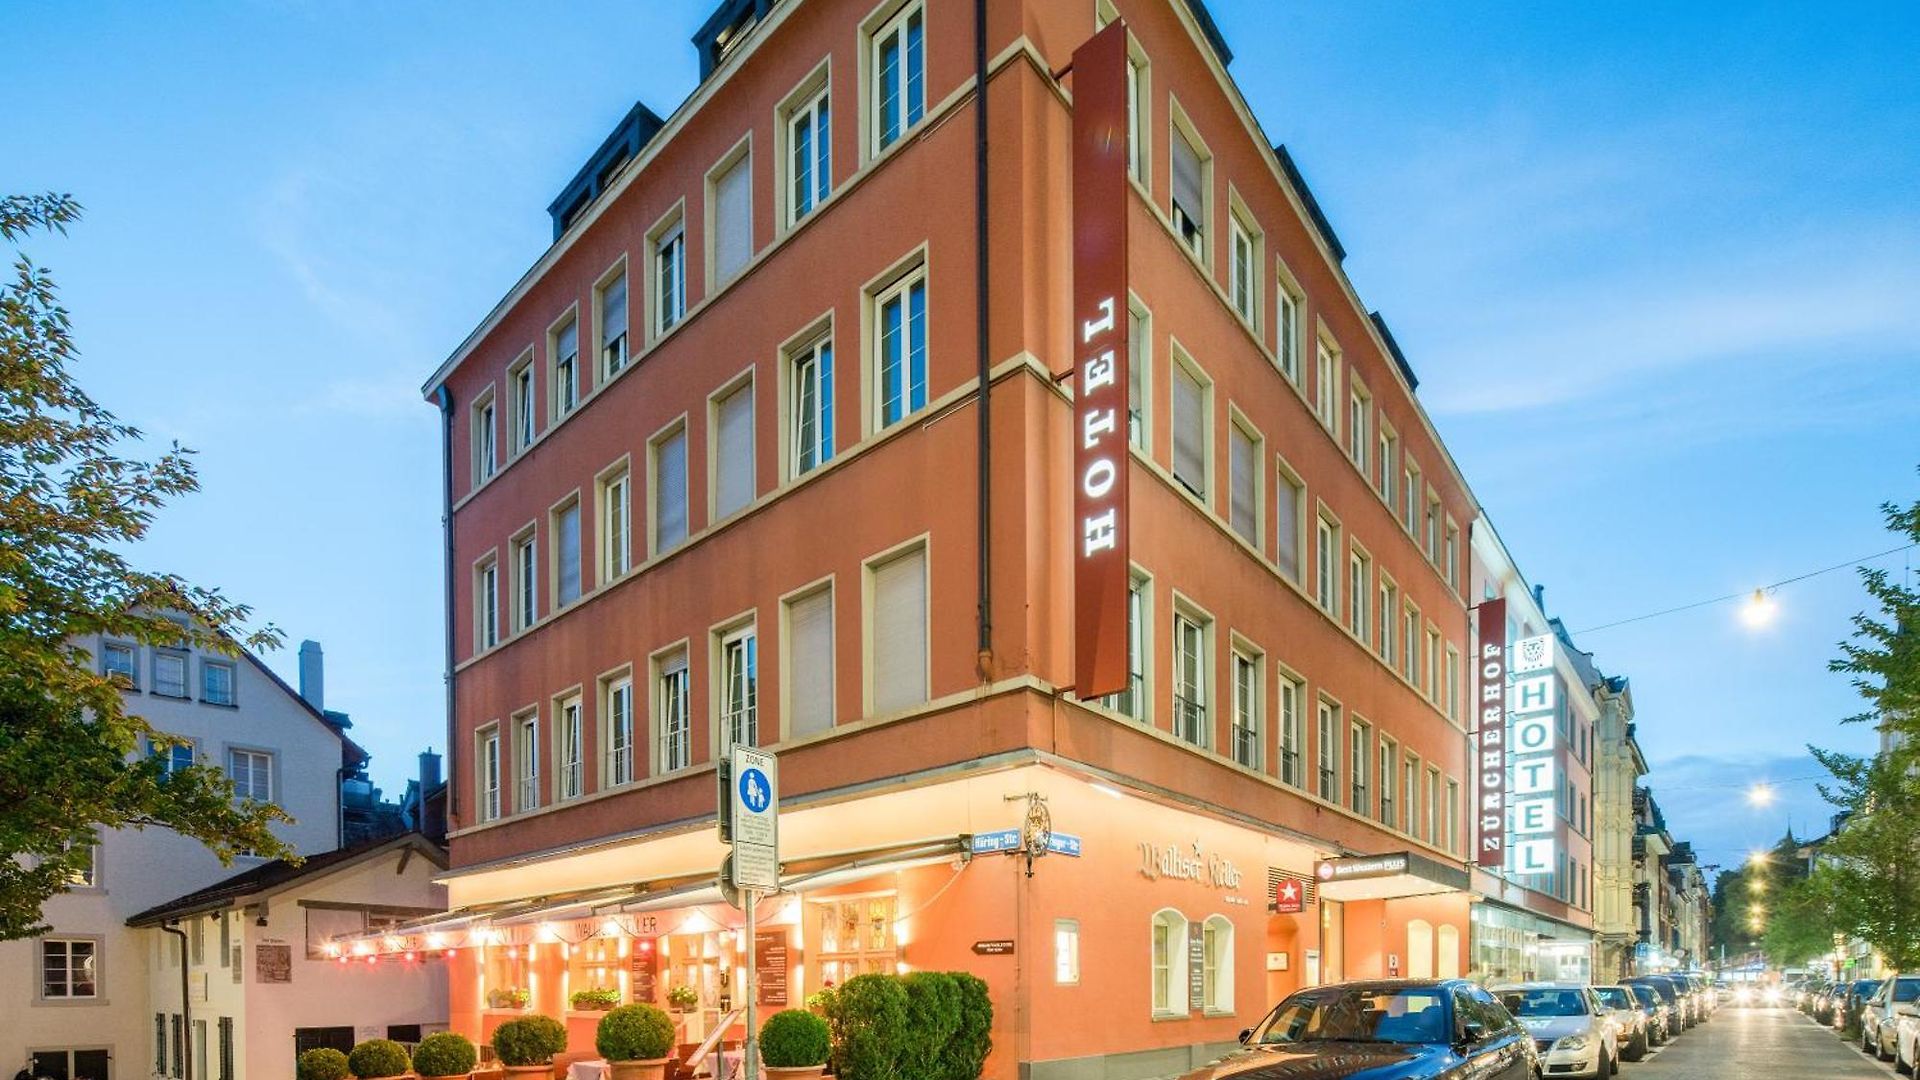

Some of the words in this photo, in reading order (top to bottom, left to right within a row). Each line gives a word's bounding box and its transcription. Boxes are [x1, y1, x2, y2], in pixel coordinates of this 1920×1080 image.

[1084, 296, 1115, 557] HOTEL
[745, 754, 765, 767] ZONE
[1481, 643, 1501, 851] ZÜRCHERHOF
[1520, 682, 1547, 870] HOTEL
[1335, 865, 1353, 875] Best
[1353, 861, 1383, 873] Western
[1384, 858, 1406, 871] PLUS
